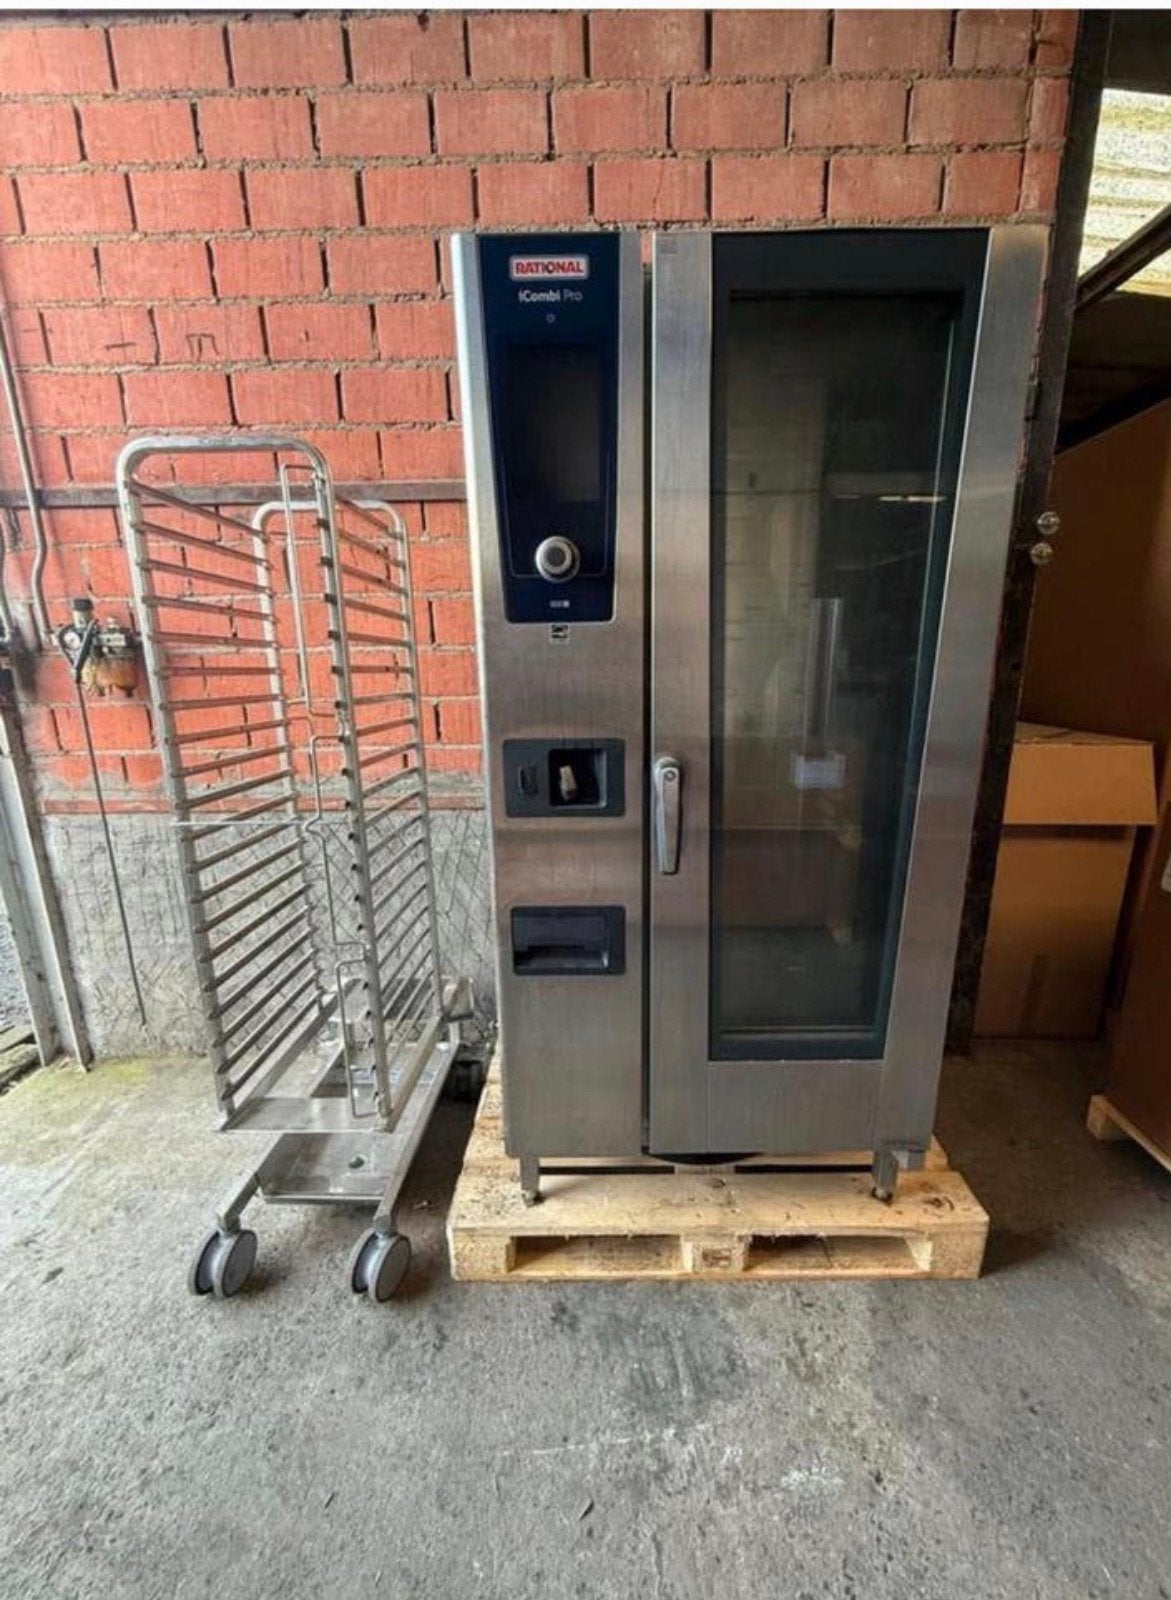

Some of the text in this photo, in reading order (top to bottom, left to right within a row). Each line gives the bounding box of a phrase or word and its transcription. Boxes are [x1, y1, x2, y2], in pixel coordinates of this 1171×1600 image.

[515, 260, 584, 274] RATIONAL
[518, 289, 584, 302] iCombi Pro
